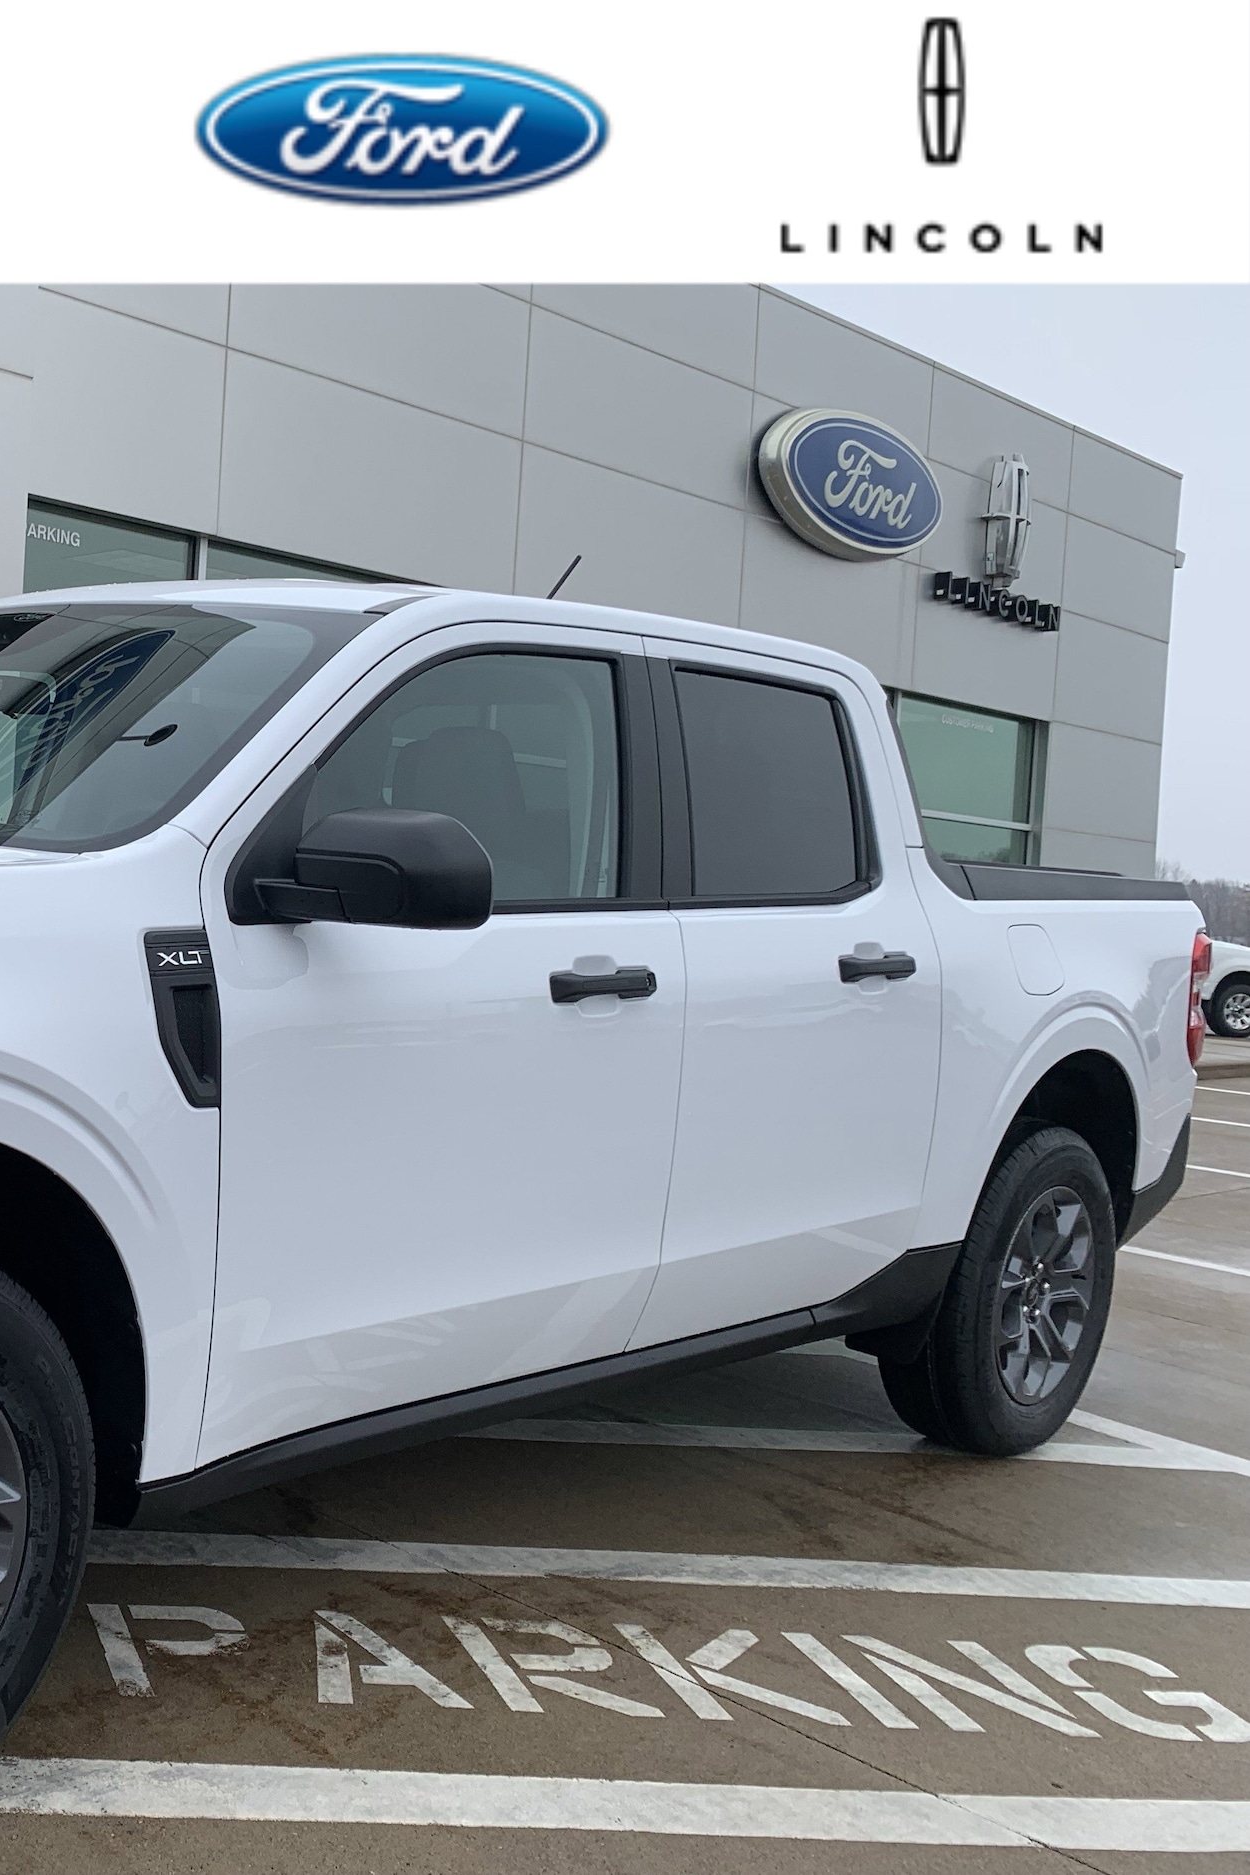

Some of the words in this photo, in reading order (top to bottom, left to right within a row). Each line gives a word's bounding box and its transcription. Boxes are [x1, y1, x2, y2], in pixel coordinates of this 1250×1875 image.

[824, 439, 917, 529] Ford
[26, 523, 81, 547] ARKING
[156, 949, 210, 967] XLT
[87, 1603, 1250, 1743] PARKING
